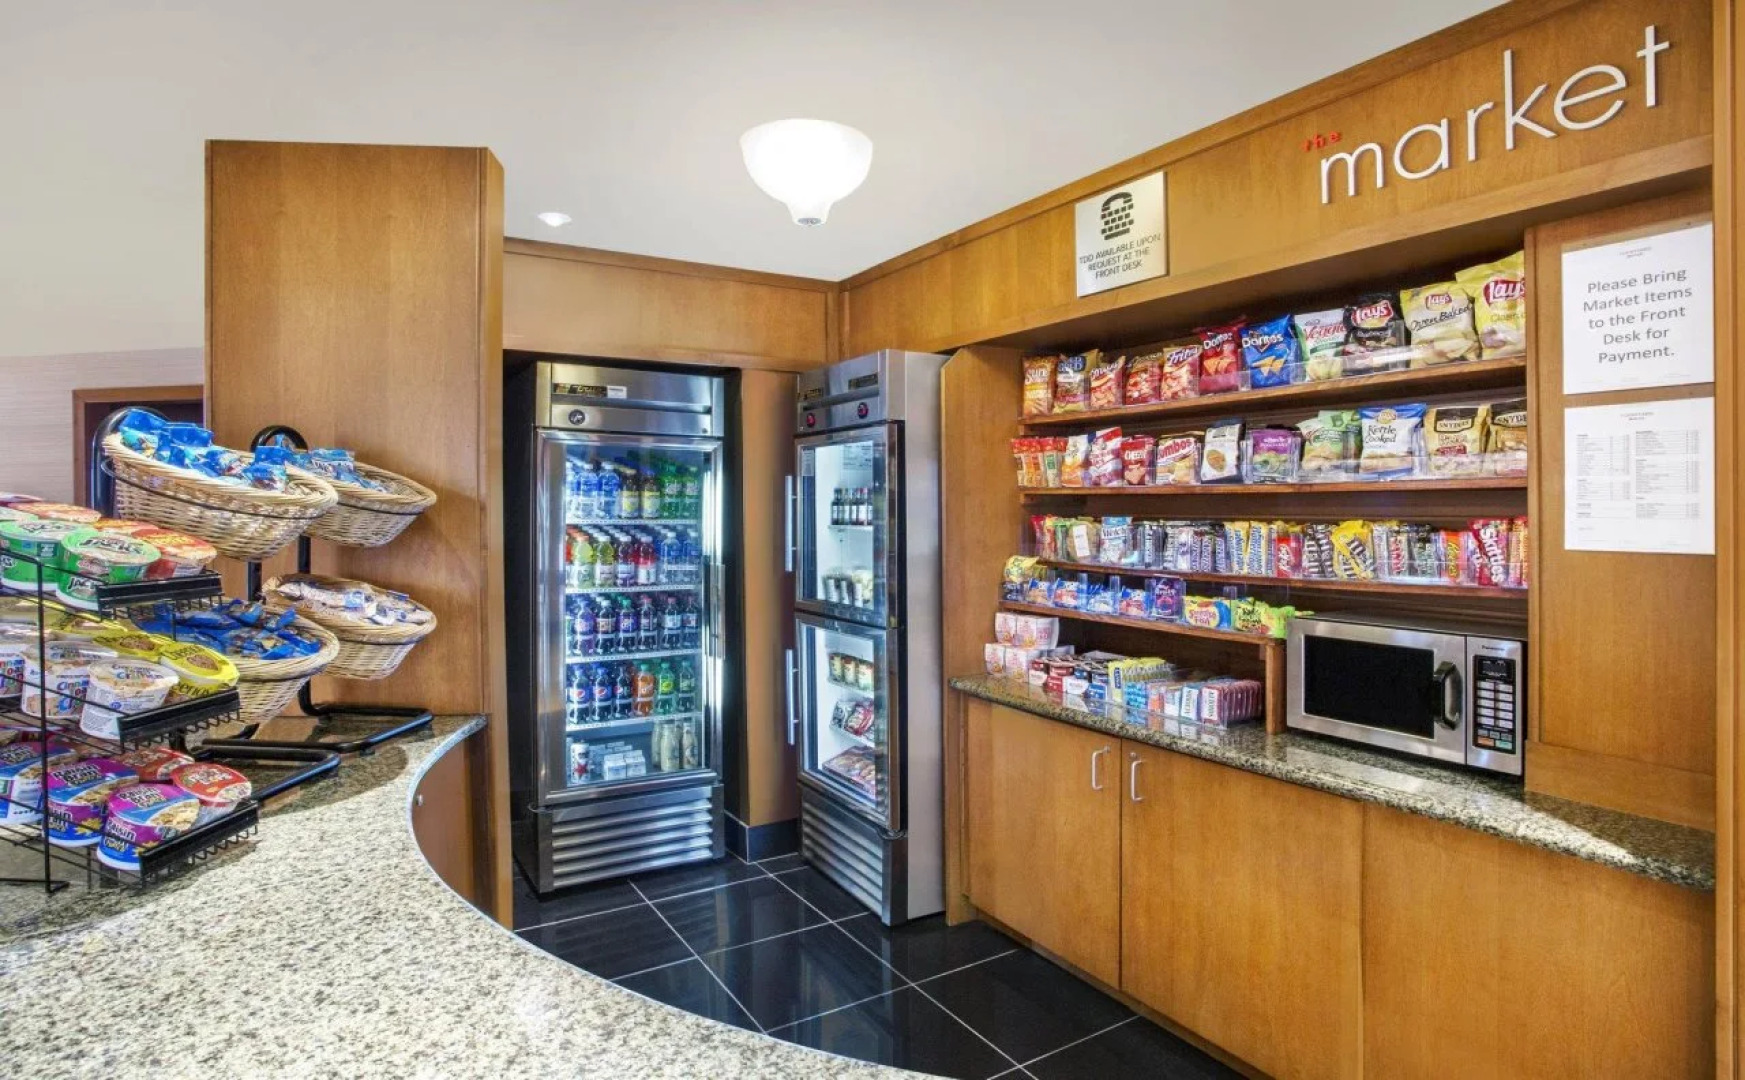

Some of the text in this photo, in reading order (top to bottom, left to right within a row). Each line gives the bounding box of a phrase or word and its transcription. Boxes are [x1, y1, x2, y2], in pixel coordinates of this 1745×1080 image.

[1320, 24, 1670, 204] market
[1302, 131, 1341, 153] the
[1080, 233, 1161, 264] TDD AVAILABLE UPON
[1088, 246, 1150, 271] REQUEST AT THE
[1095, 260, 1143, 279] FRONT DESK
[1587, 269, 1687, 294] Please Bring
[1583, 287, 1693, 313] Market Items
[1589, 305, 1686, 330] to the Front
[1241, 333, 1284, 348] Doritos
[1603, 327, 1670, 346] Desk for
[1598, 346, 1675, 364] Payment.
